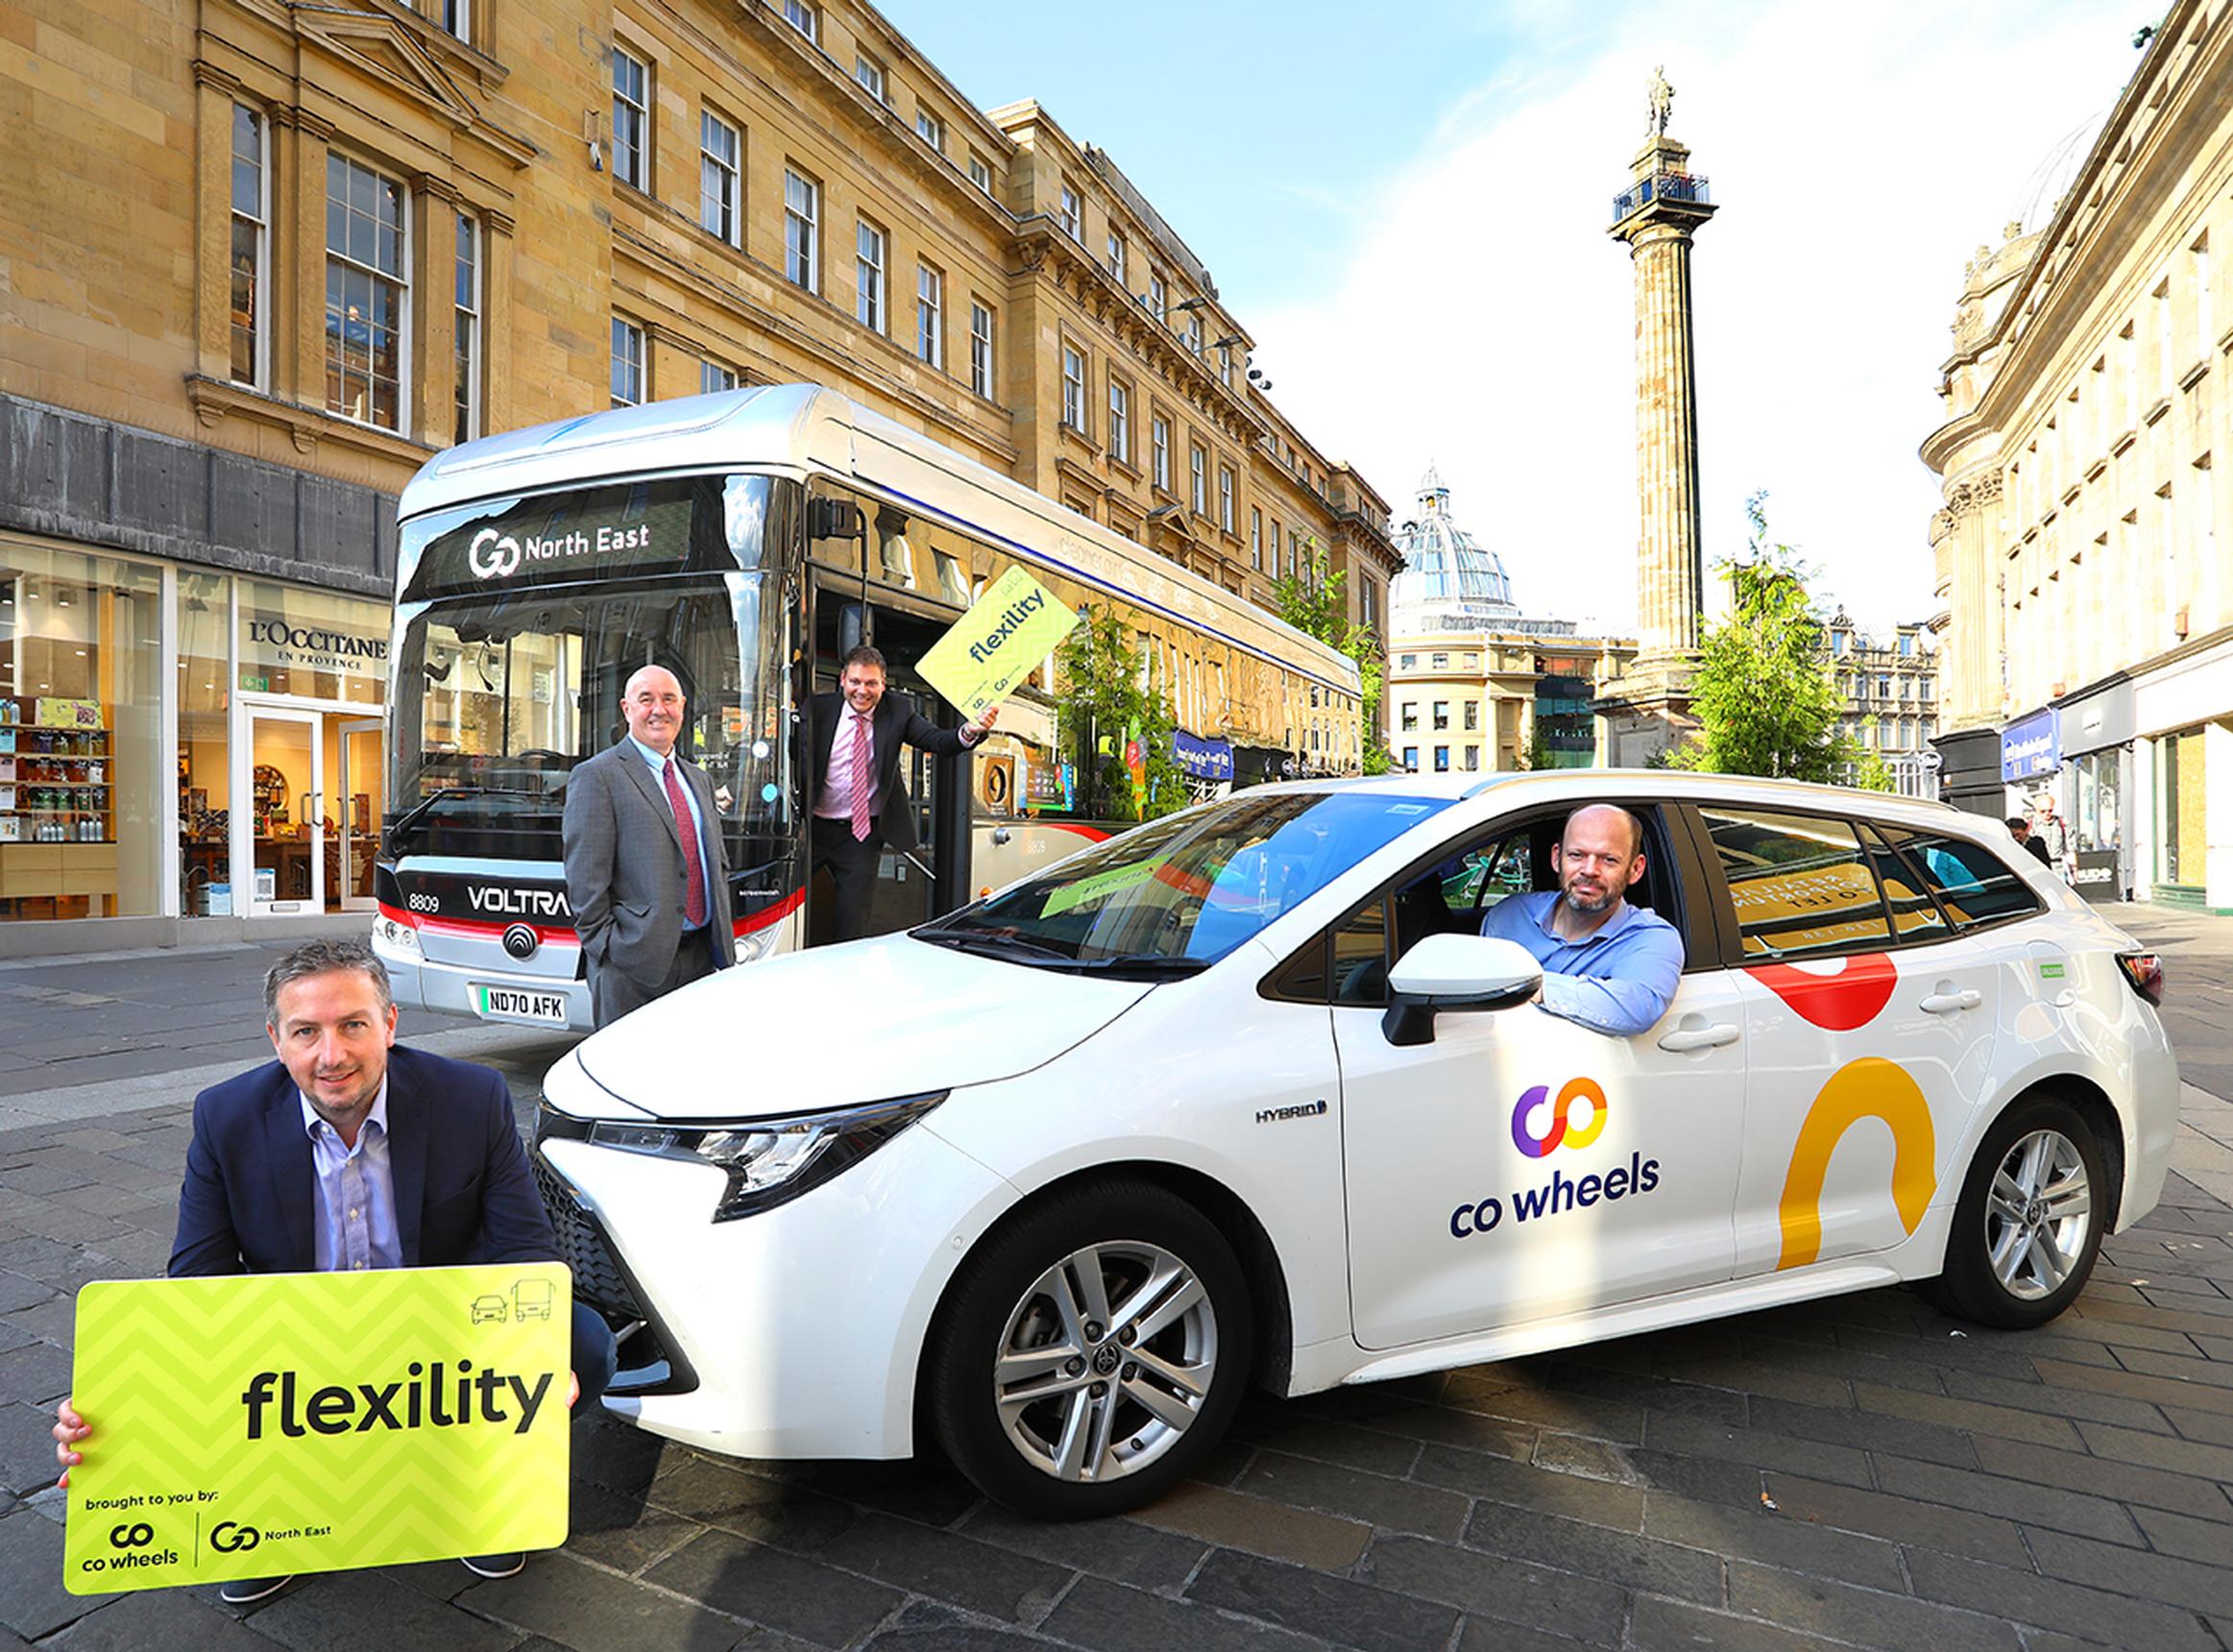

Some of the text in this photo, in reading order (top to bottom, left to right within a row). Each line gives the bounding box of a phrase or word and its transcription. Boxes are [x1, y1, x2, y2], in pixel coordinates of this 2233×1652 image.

[525, 530, 590, 561] North
[596, 524, 649, 552] East
[969, 588, 1045, 664] flexility
[278, 650, 362, 670] EN PROVENCE
[408, 887, 571, 916] 8809 VOLTRA
[490, 991, 563, 1018] ND70 AFK
[1255, 1103, 1318, 1124] HYBRID
[1449, 1151, 1662, 1239] co wheels
[242, 1359, 554, 1440] flexility
[85, 1490, 218, 1511] brought to you by:
[265, 1527, 302, 1541] North
[304, 1525, 331, 1537] East
[82, 1549, 179, 1572] co wheels
